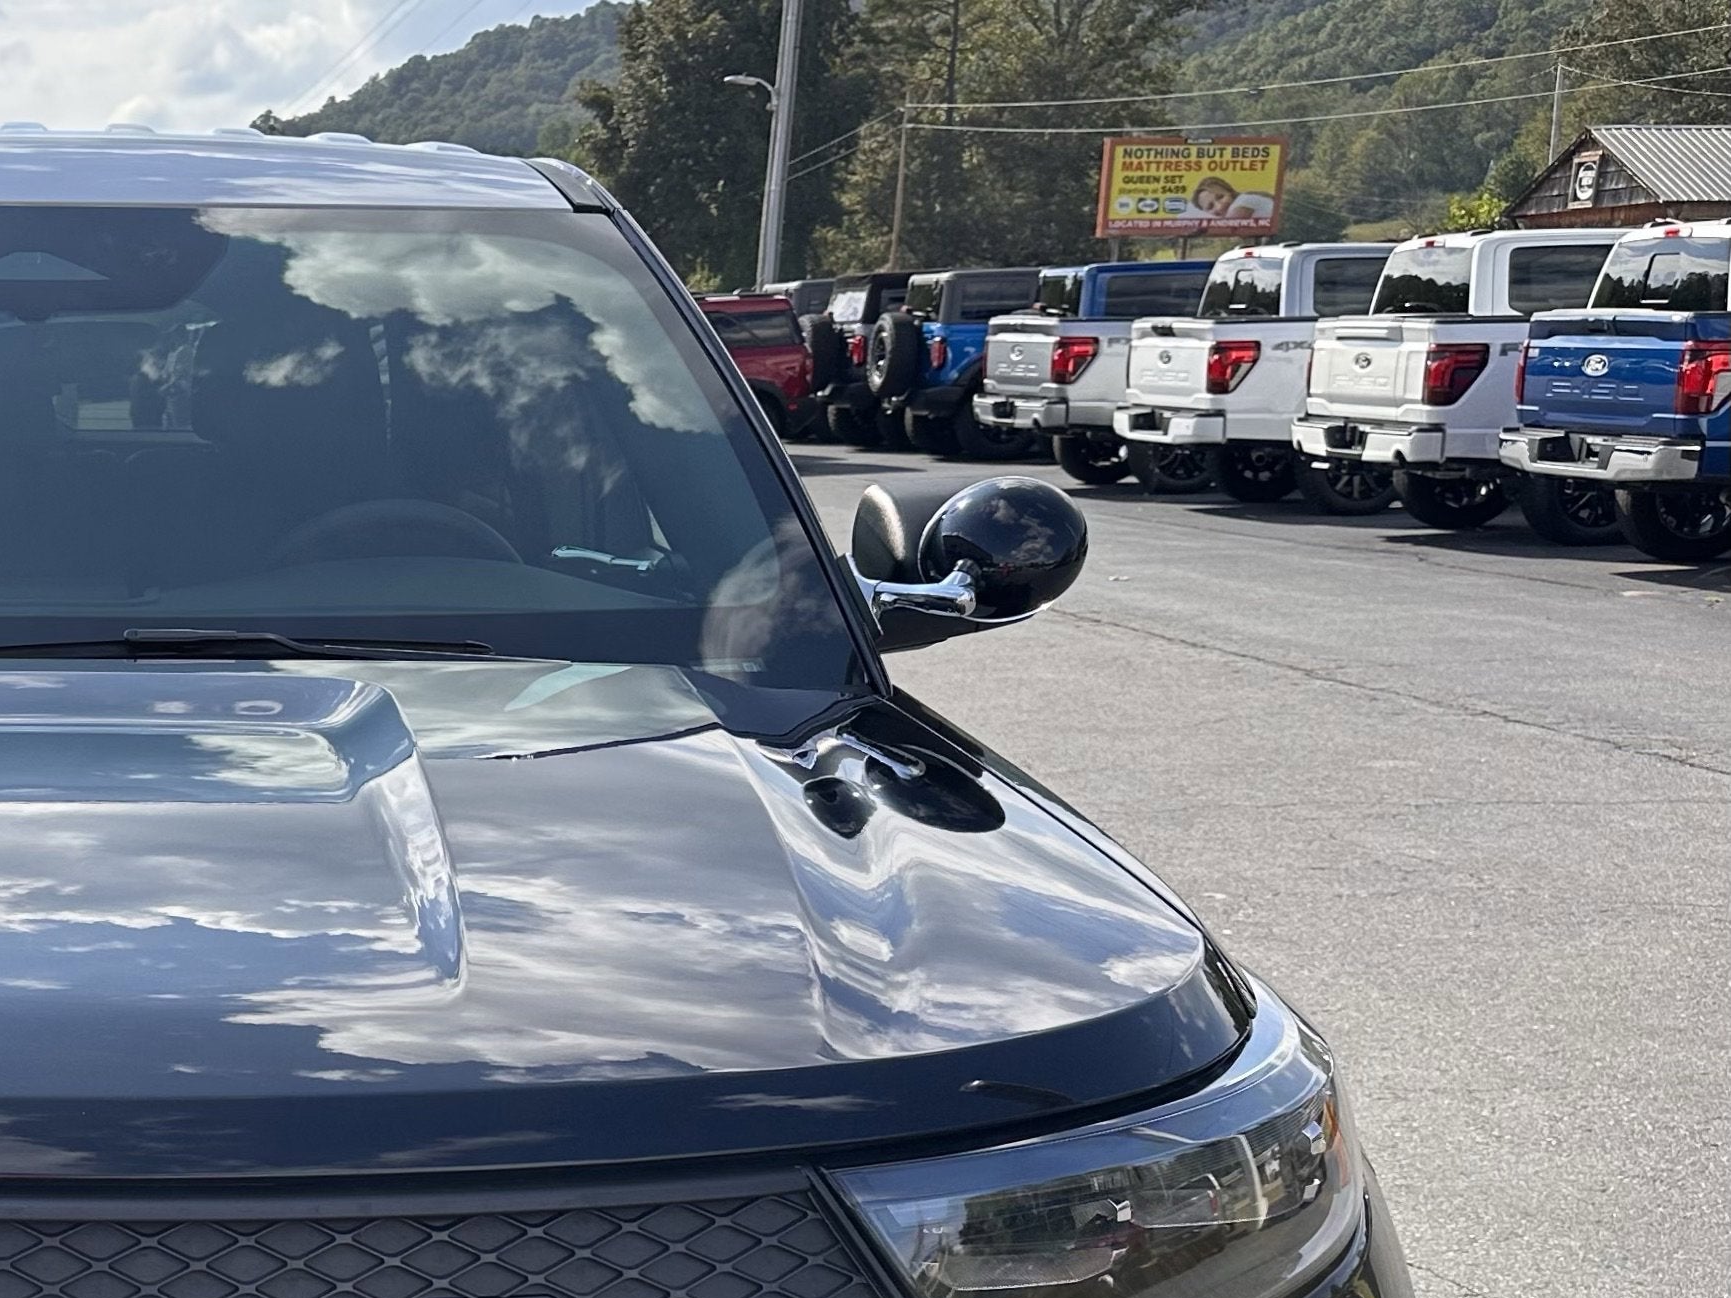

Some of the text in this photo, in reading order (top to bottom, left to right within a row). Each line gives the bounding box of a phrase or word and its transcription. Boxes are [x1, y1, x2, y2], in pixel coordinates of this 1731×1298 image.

[1122, 146, 1271, 160] NOTHING BUT BEDS
[1120, 159, 1269, 172] MATTRESS OUTLET
[1122, 174, 1185, 185] QUEEN SET
[1108, 219, 1150, 229] LOCATED
[1151, 219, 1163, 228] IN
[1163, 219, 1199, 228] MURPHY
[1258, 218, 1271, 227] NC
